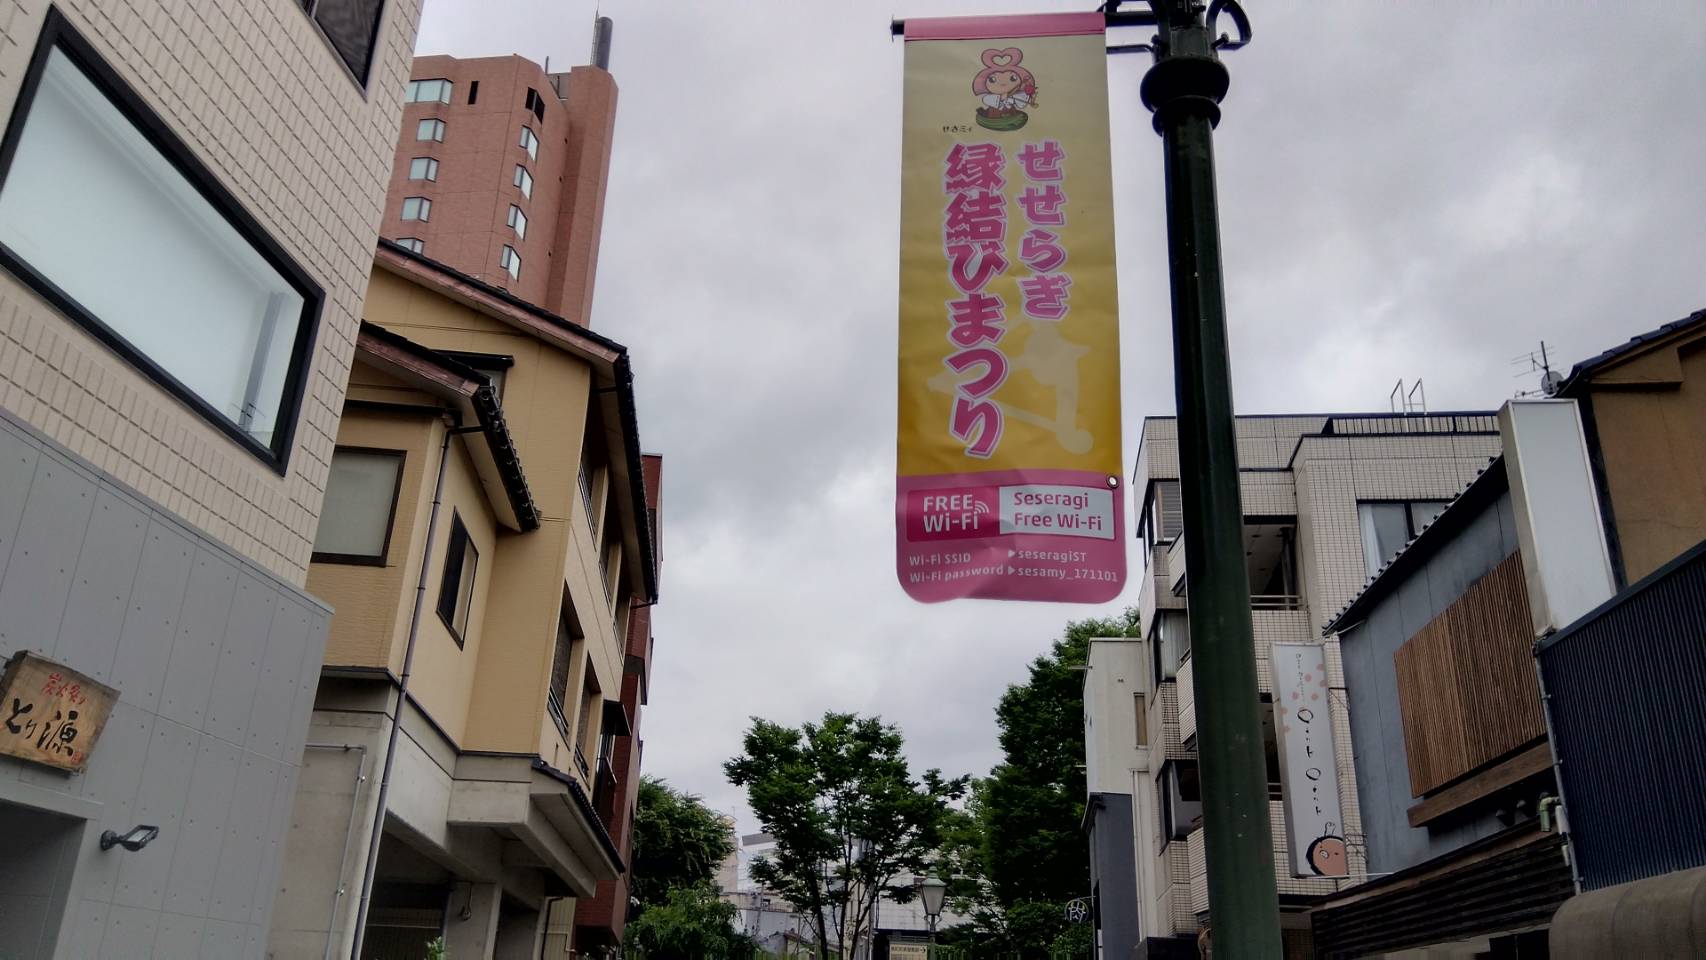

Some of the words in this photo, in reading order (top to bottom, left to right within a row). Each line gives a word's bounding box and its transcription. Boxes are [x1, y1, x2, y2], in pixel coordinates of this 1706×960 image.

[1016, 140, 1072, 321] せせらぎ
[944, 142, 1009, 459] 縁結びまつり
[923, 494, 974, 513] FREE
[1014, 491, 1089, 510] Seseragi
[923, 512, 979, 533] Wi-Fi
[1014, 512, 1052, 528] Free
[1057, 514, 1102, 531] Wi-Fi
[909, 554, 942, 567] Wi-Fi
[944, 552, 971, 564] SSID
[909, 571, 942, 584] Wi-Fi
[944, 564, 1004, 581] password
